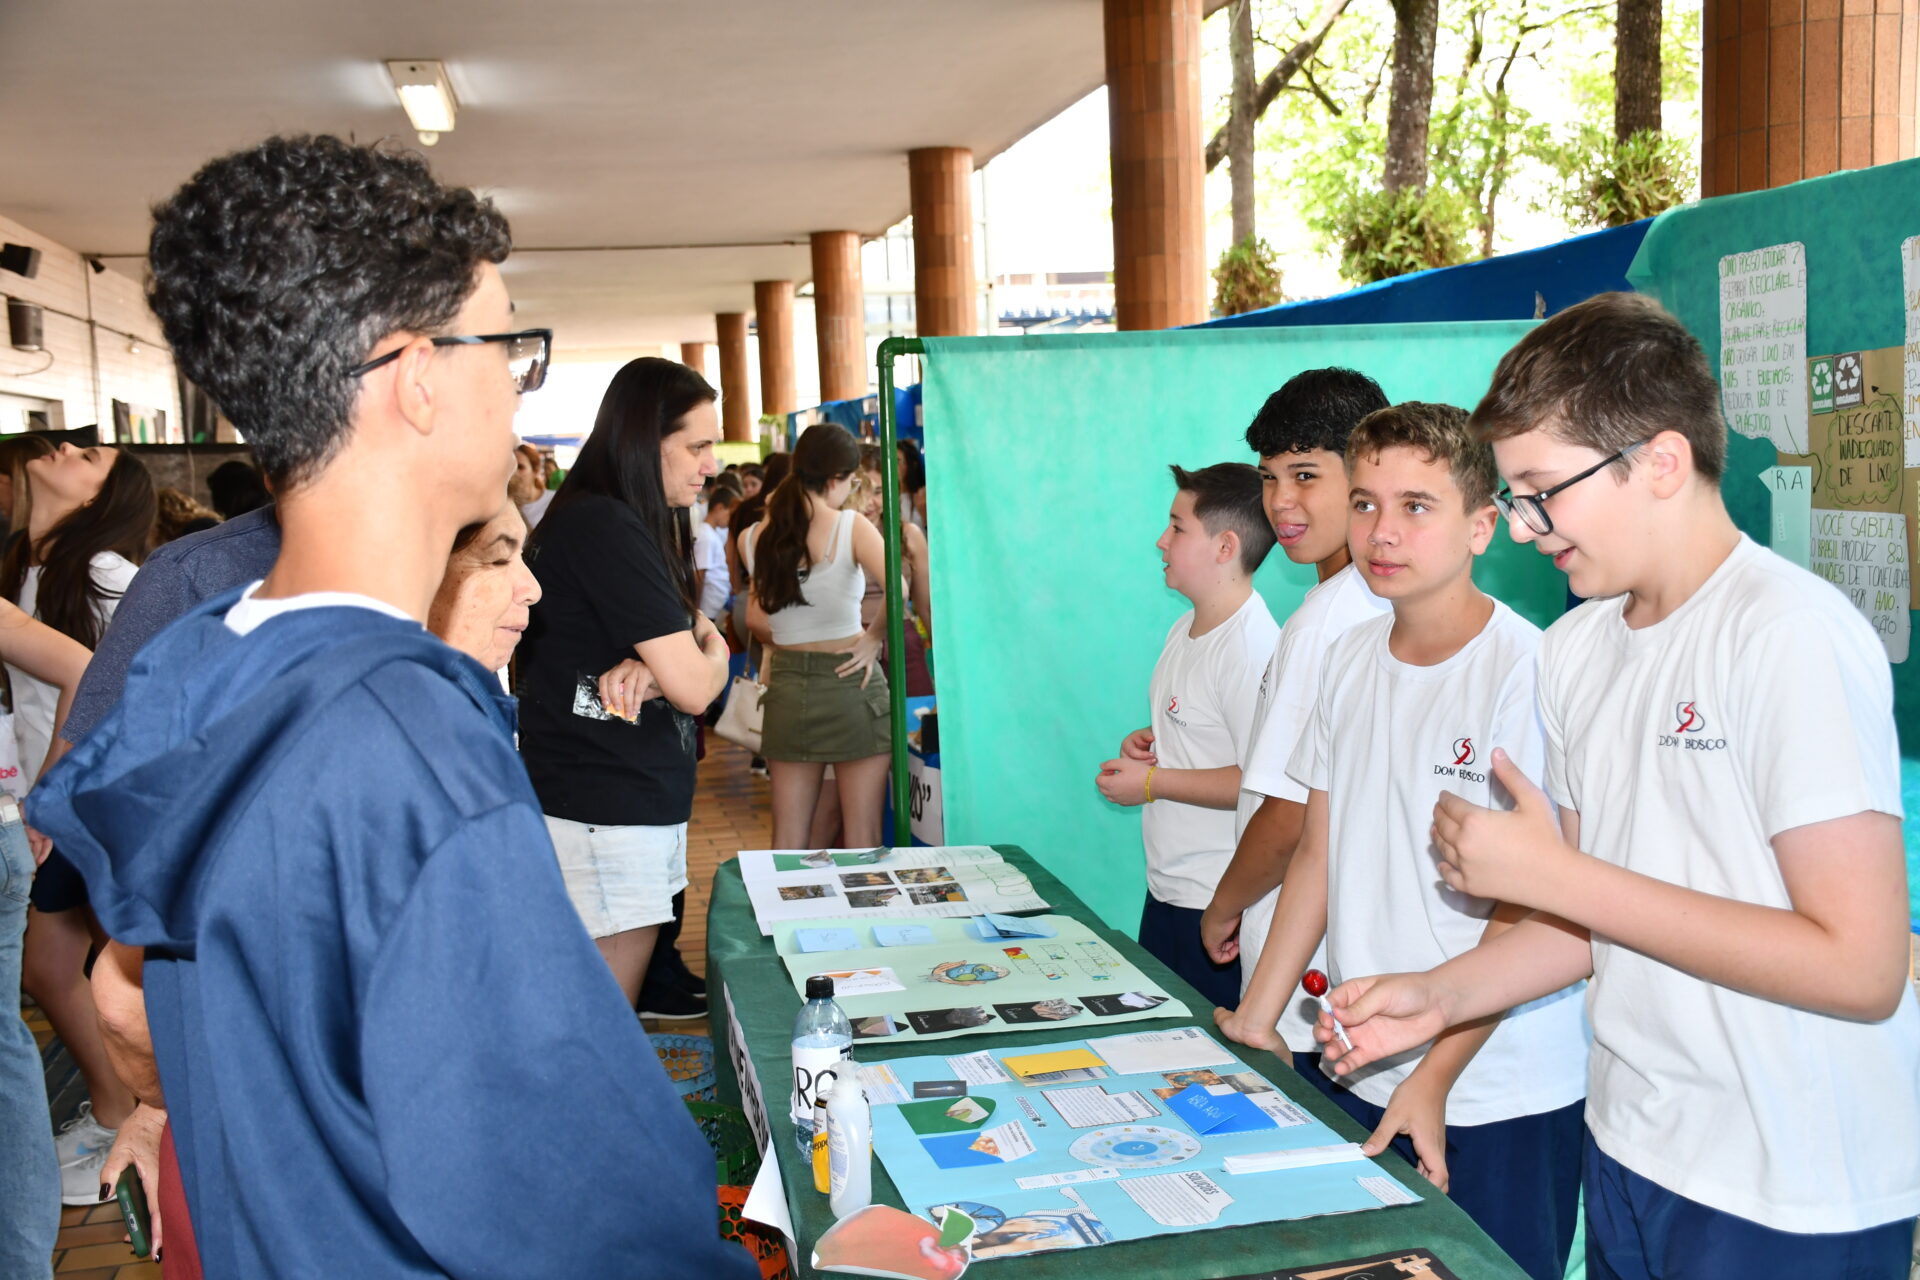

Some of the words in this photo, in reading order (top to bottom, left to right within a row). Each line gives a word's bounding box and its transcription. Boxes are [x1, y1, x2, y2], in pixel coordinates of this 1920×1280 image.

[1838, 410, 1892, 437] DESCARTE
[1840, 467, 1854, 487] DE
[1851, 517, 1893, 538] SABIA
[1817, 540, 1839, 560] BRASIL
[1841, 541, 1877, 562] PRODUZ
[1886, 542, 1905, 564] 82
[1848, 564, 1865, 586] DE
[1684, 738, 1727, 751] BOSCO
[1434, 764, 1456, 777] DOM
